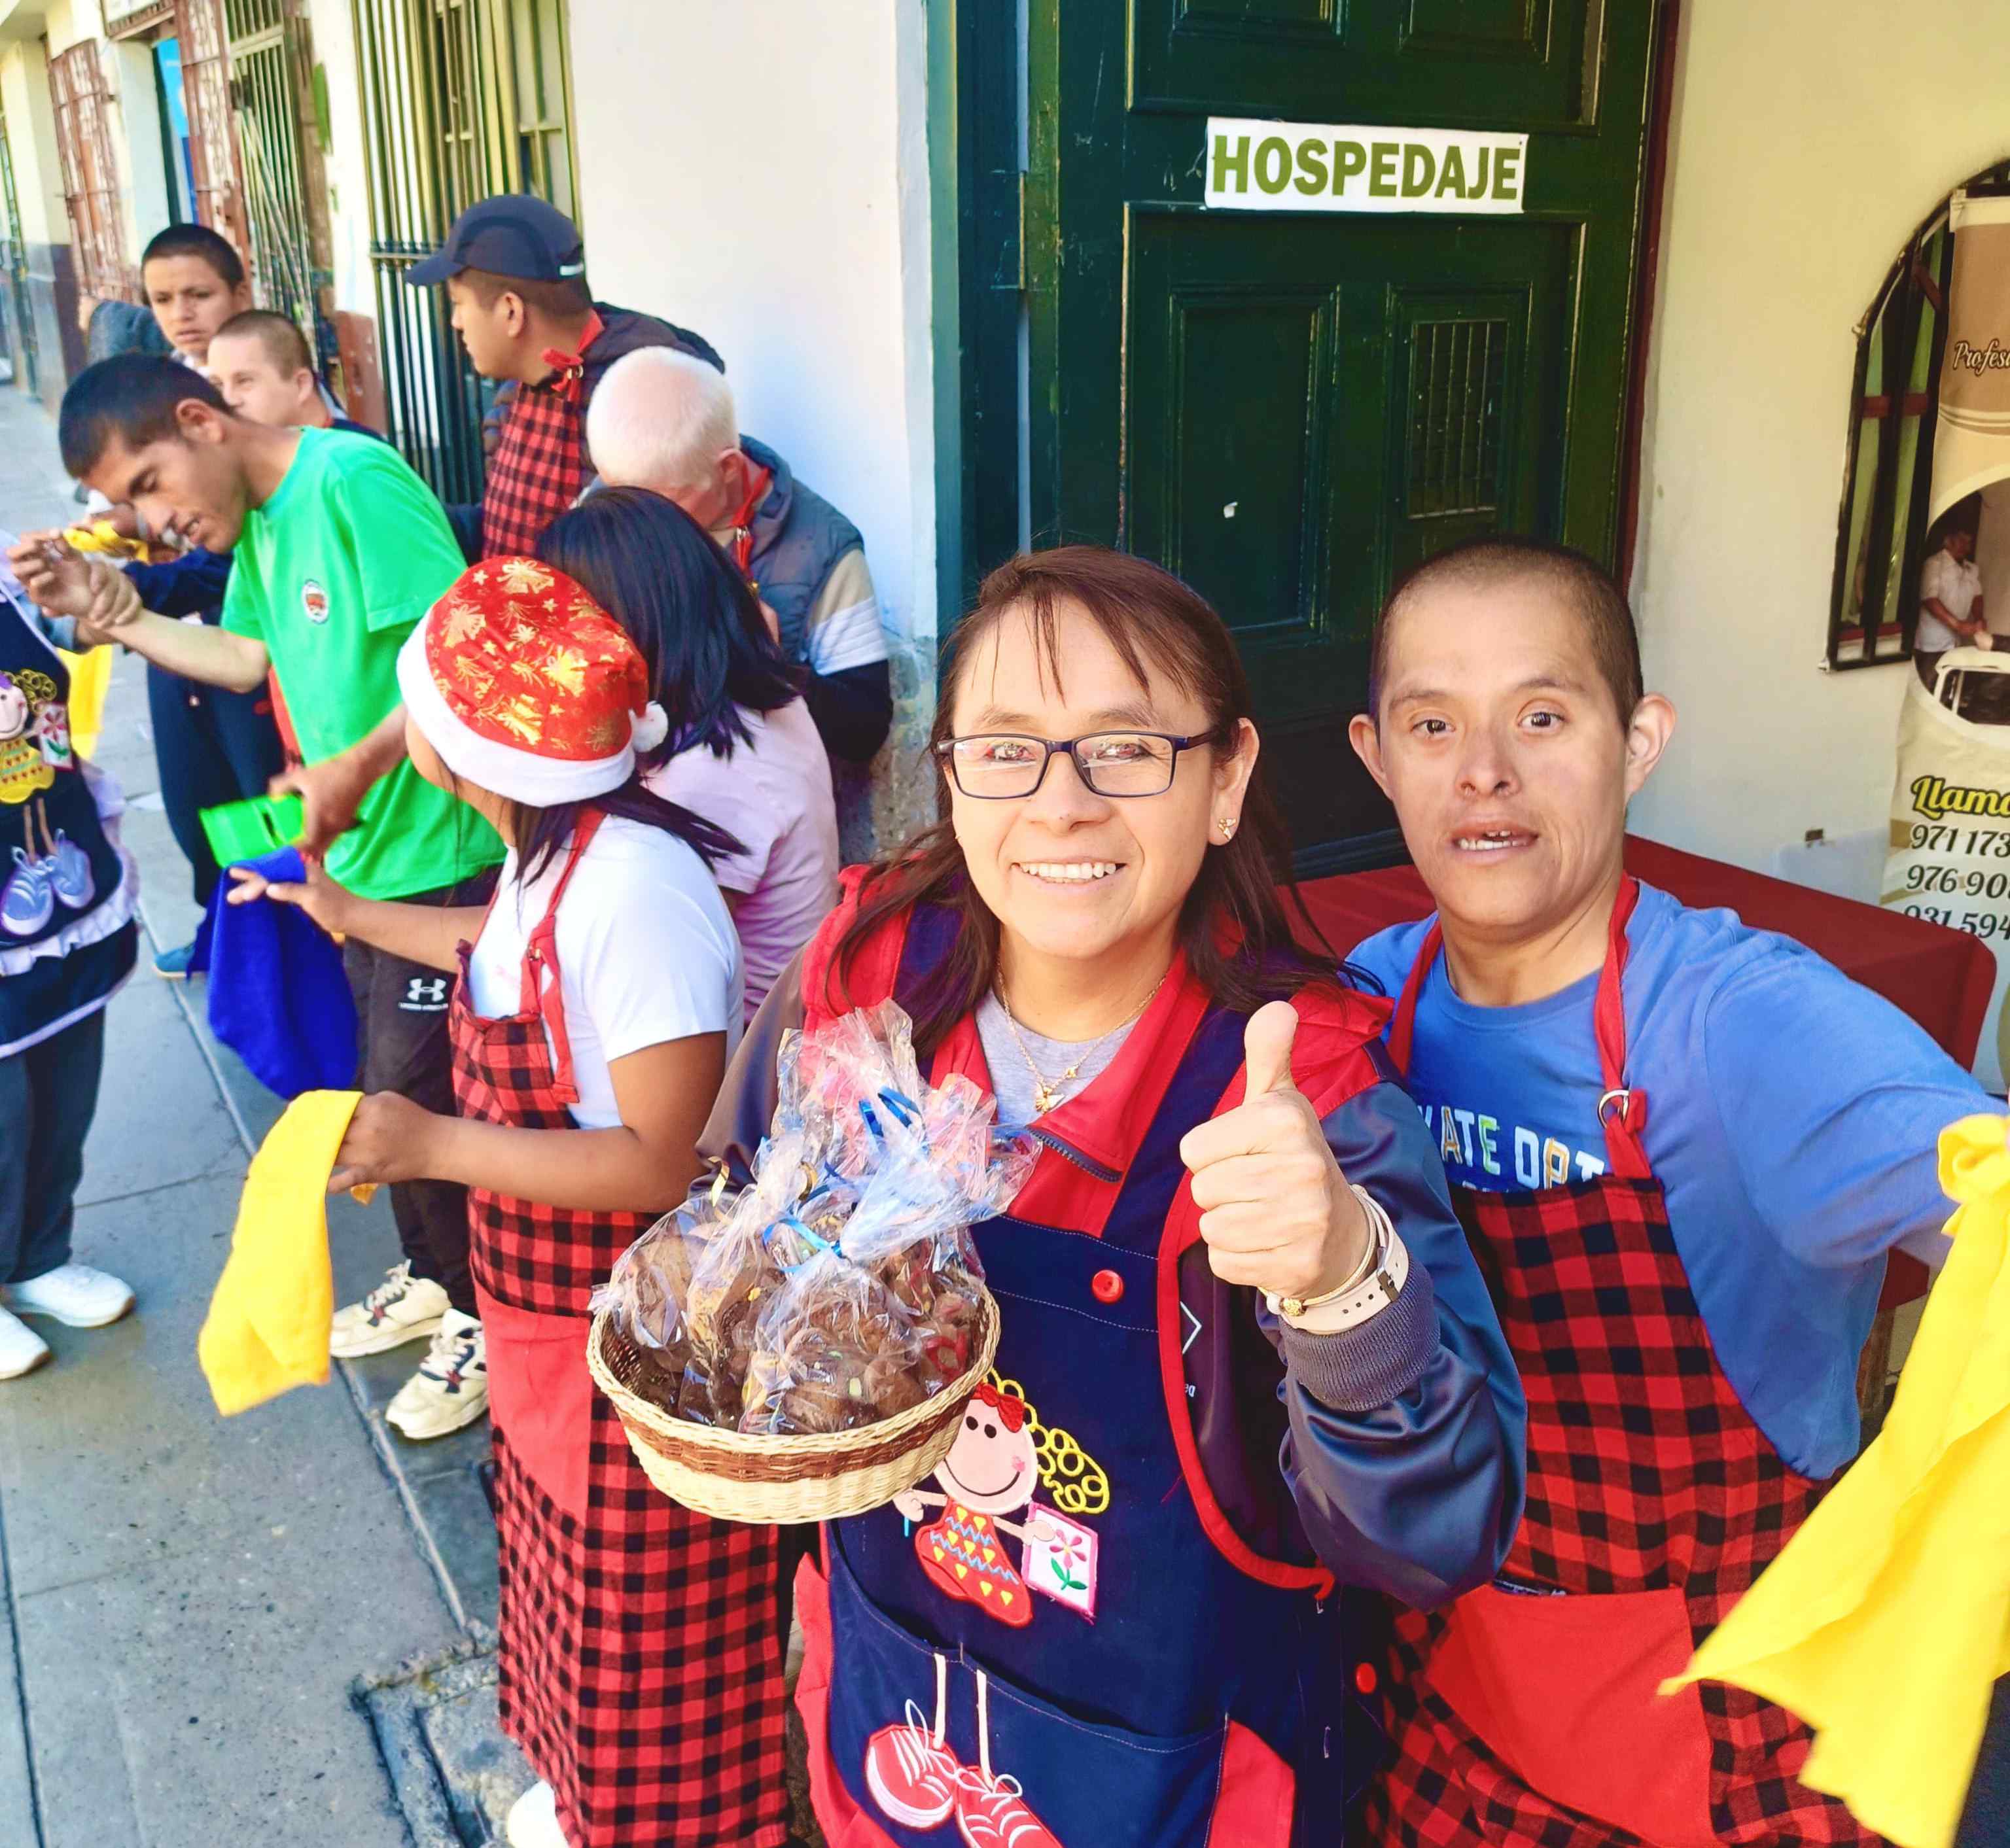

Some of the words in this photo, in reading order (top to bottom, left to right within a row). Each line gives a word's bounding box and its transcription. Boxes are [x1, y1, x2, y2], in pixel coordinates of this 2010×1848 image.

[1212, 135, 1521, 200] HOSPEDAJE
[1952, 338, 2010, 377] Profes
[1911, 824, 1959, 852] 971
[1965, 829, 2010, 858] 173
[1907, 864, 1958, 894] 976
[1966, 871, 2010, 899] 90
[1959, 913, 2010, 941] 594
